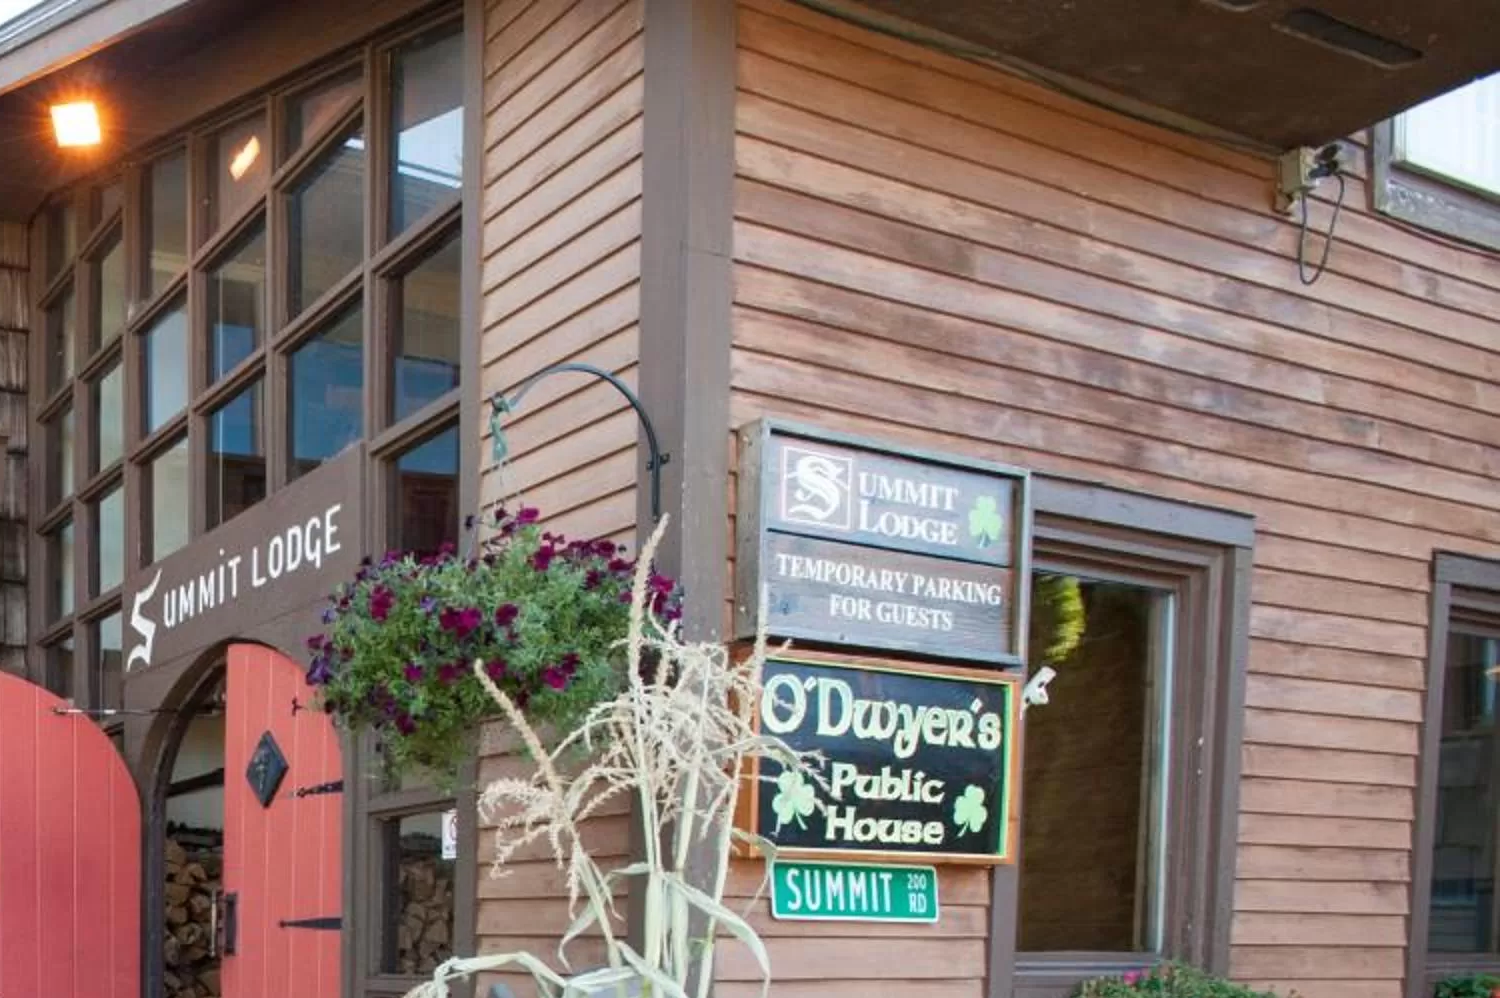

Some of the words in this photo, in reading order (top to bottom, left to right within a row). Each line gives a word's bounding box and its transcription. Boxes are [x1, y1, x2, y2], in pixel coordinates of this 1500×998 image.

[858, 500, 958, 545] LODGE
[251, 503, 342, 588] LODGE
[776, 553, 909, 593] TEMPORARY
[911, 574, 1002, 606] PARKING
[829, 594, 872, 621] FOR
[876, 602, 954, 631] GUESTS
[830, 761, 946, 804] Public
[825, 805, 945, 845] House
[787, 868, 893, 912] SUMMIT
[909, 893, 927, 912] RD
